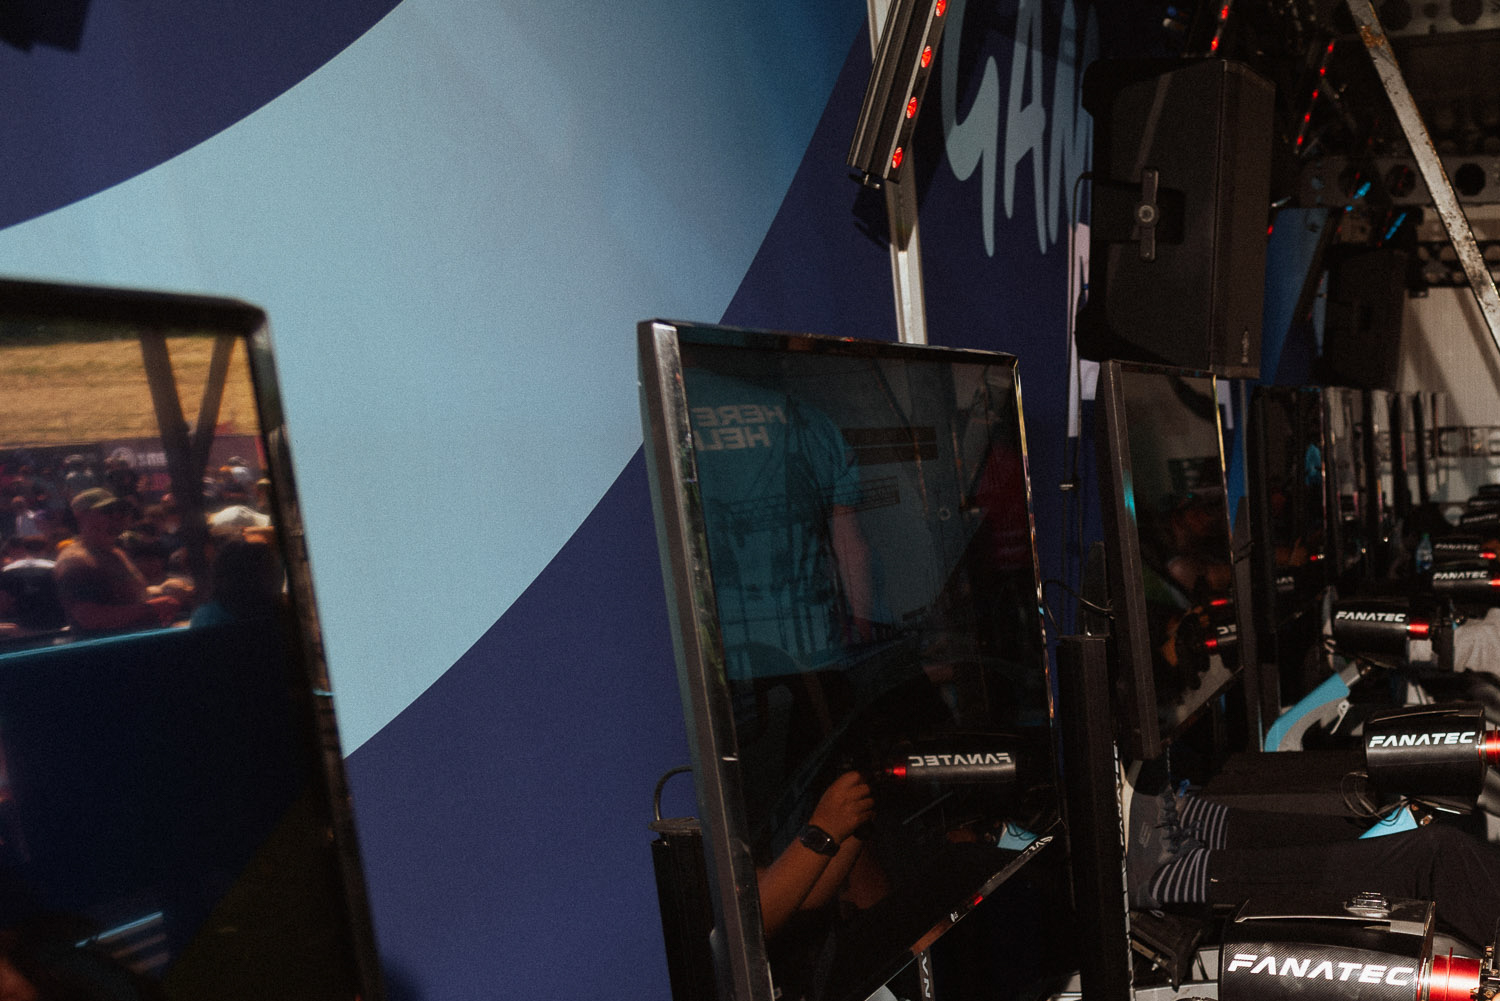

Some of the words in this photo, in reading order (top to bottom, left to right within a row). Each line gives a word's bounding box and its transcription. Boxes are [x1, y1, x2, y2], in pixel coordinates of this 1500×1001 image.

[1433, 571, 1488, 580] FANATEC
[1335, 611, 1406, 622] FANATEC
[1369, 732, 1476, 747] FANATEC
[1227, 953, 1415, 987] FANATEC
